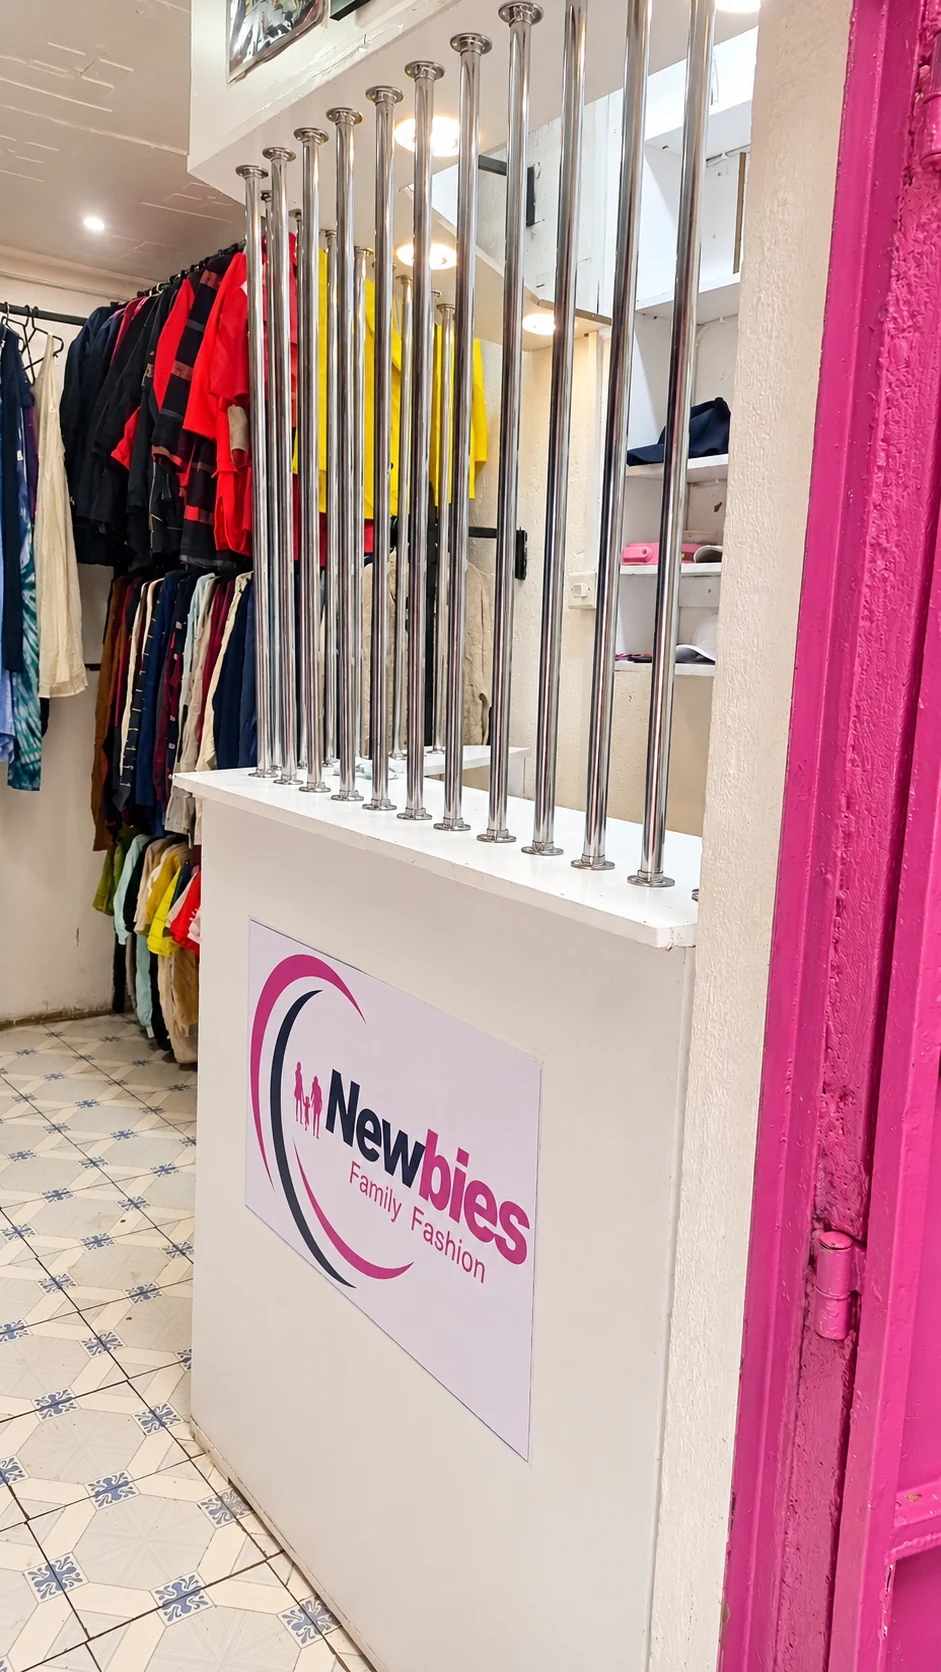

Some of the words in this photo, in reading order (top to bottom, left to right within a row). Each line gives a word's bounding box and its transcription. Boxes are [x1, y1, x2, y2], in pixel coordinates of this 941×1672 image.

[325, 1069, 530, 1265] Newbies
[349, 1161, 402, 1223] Family
[410, 1206, 486, 1284] Fashion
